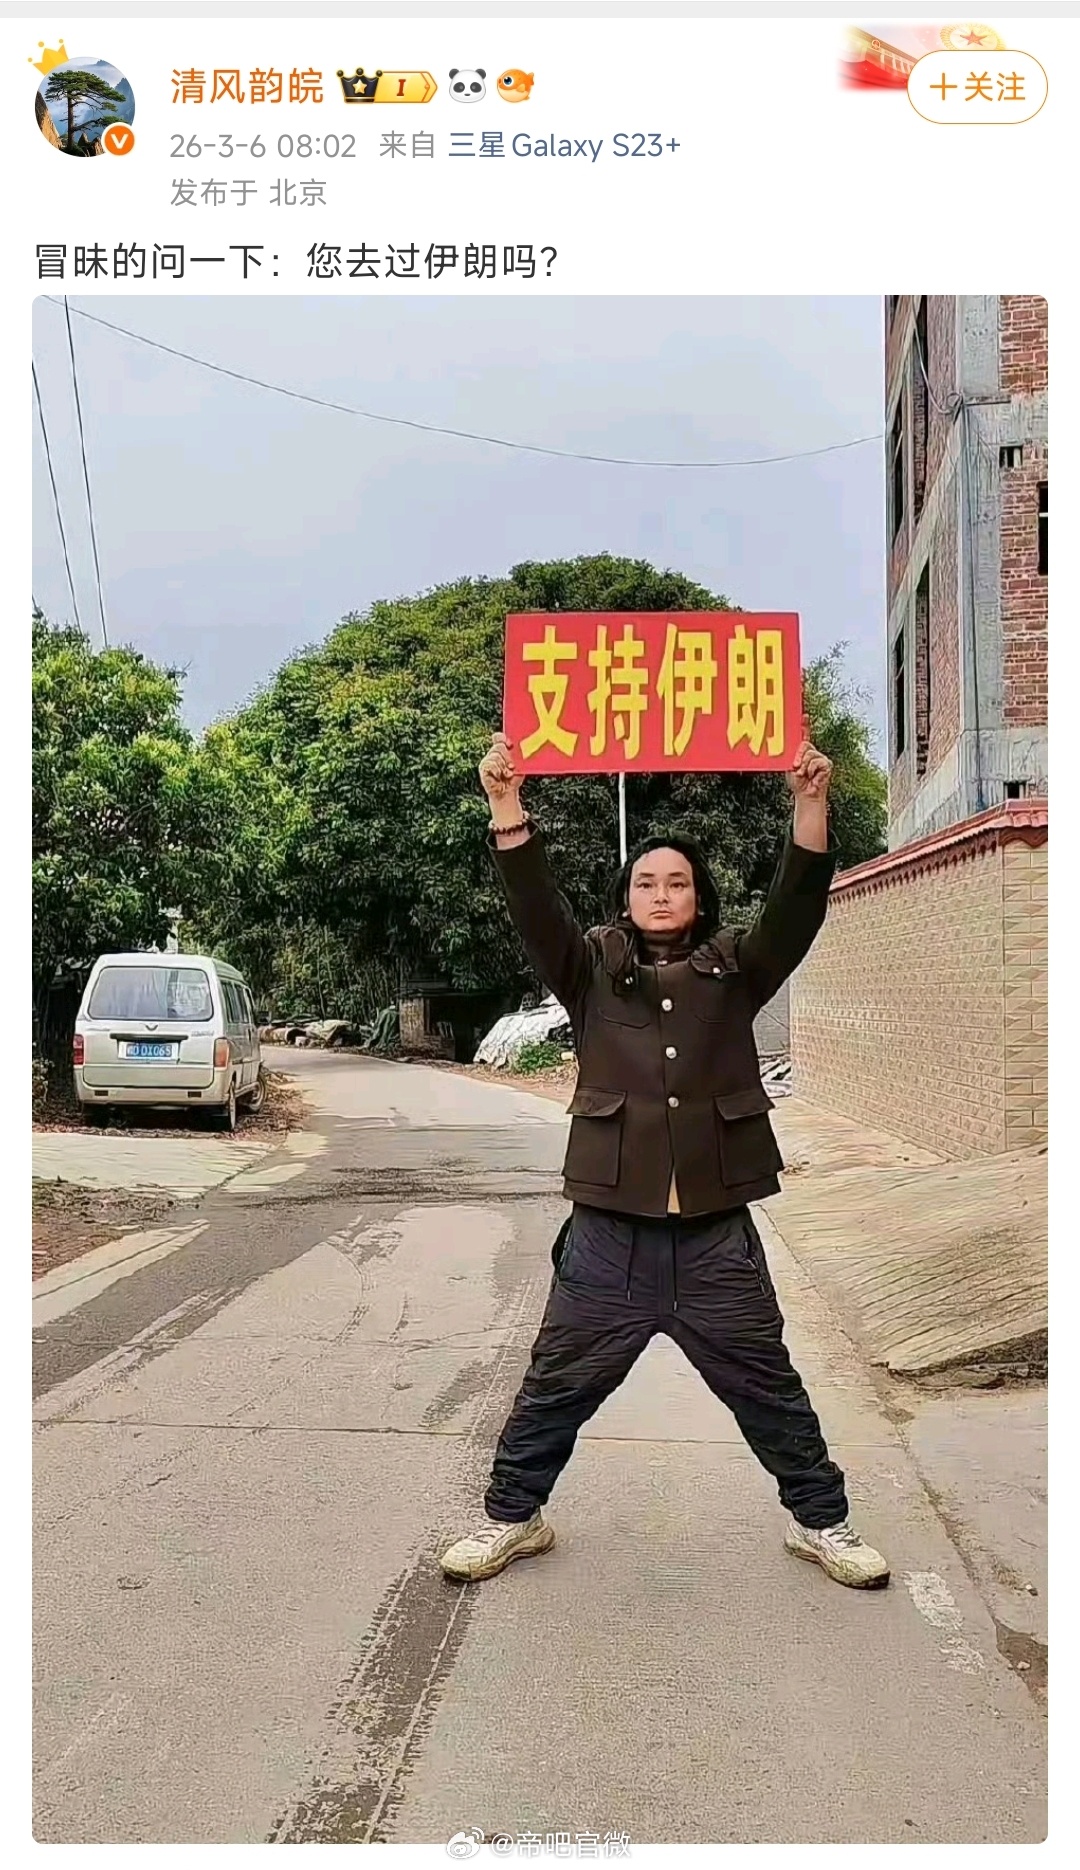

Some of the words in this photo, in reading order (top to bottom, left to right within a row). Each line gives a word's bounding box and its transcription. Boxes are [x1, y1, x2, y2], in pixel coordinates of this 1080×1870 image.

[170, 67, 324, 104] 清风韵皖
[110, 133, 129, 150] V
[170, 133, 266, 158] 26-3-6
[277, 133, 356, 158] 08:02
[379, 130, 434, 159] 来自
[612, 133, 681, 159] S23+
[170, 177, 258, 207] 发布于
[269, 178, 327, 207] 北京
[519, 623, 785, 760] 支持伊朗
